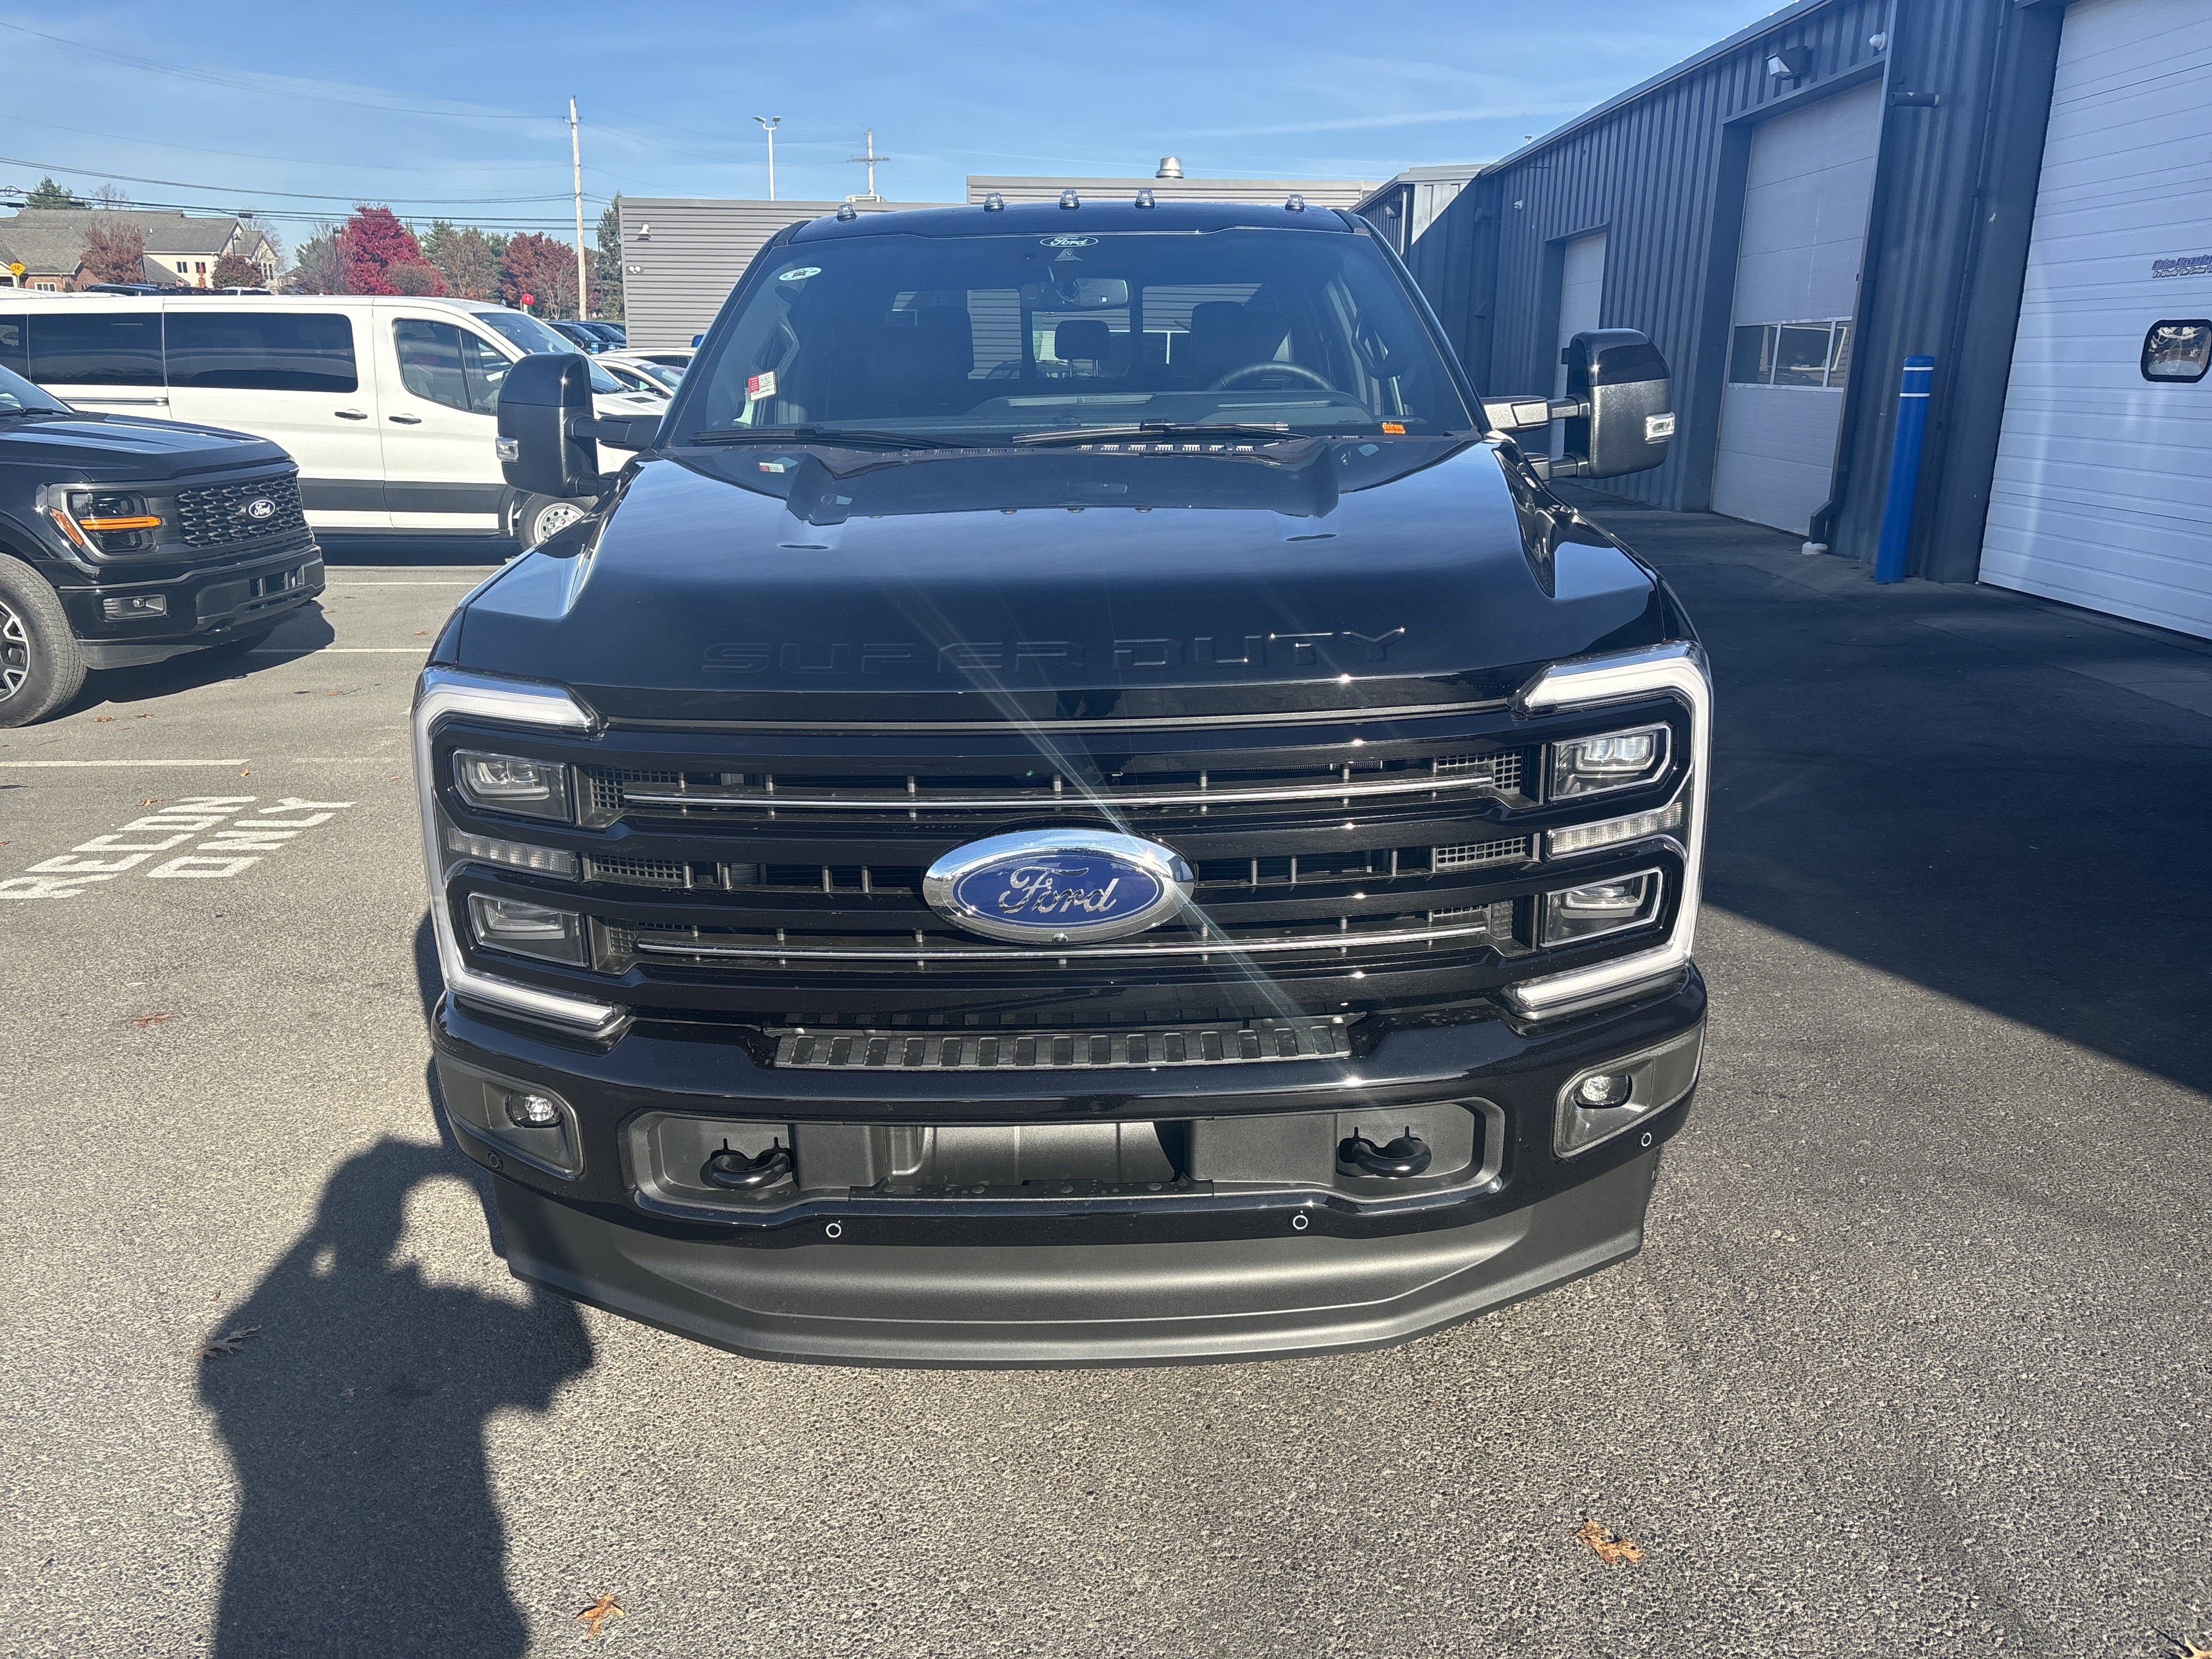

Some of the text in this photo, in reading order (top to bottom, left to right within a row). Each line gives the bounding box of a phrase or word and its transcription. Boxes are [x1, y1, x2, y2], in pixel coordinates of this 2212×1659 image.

[1050, 236, 1088, 246] Ford
[254, 502, 271, 516] Ford
[701, 627, 1406, 675] SUPER DUTY
[0, 796, 259, 899] RECON
[146, 796, 358, 878] ONLY
[998, 865, 1120, 914] Ford
